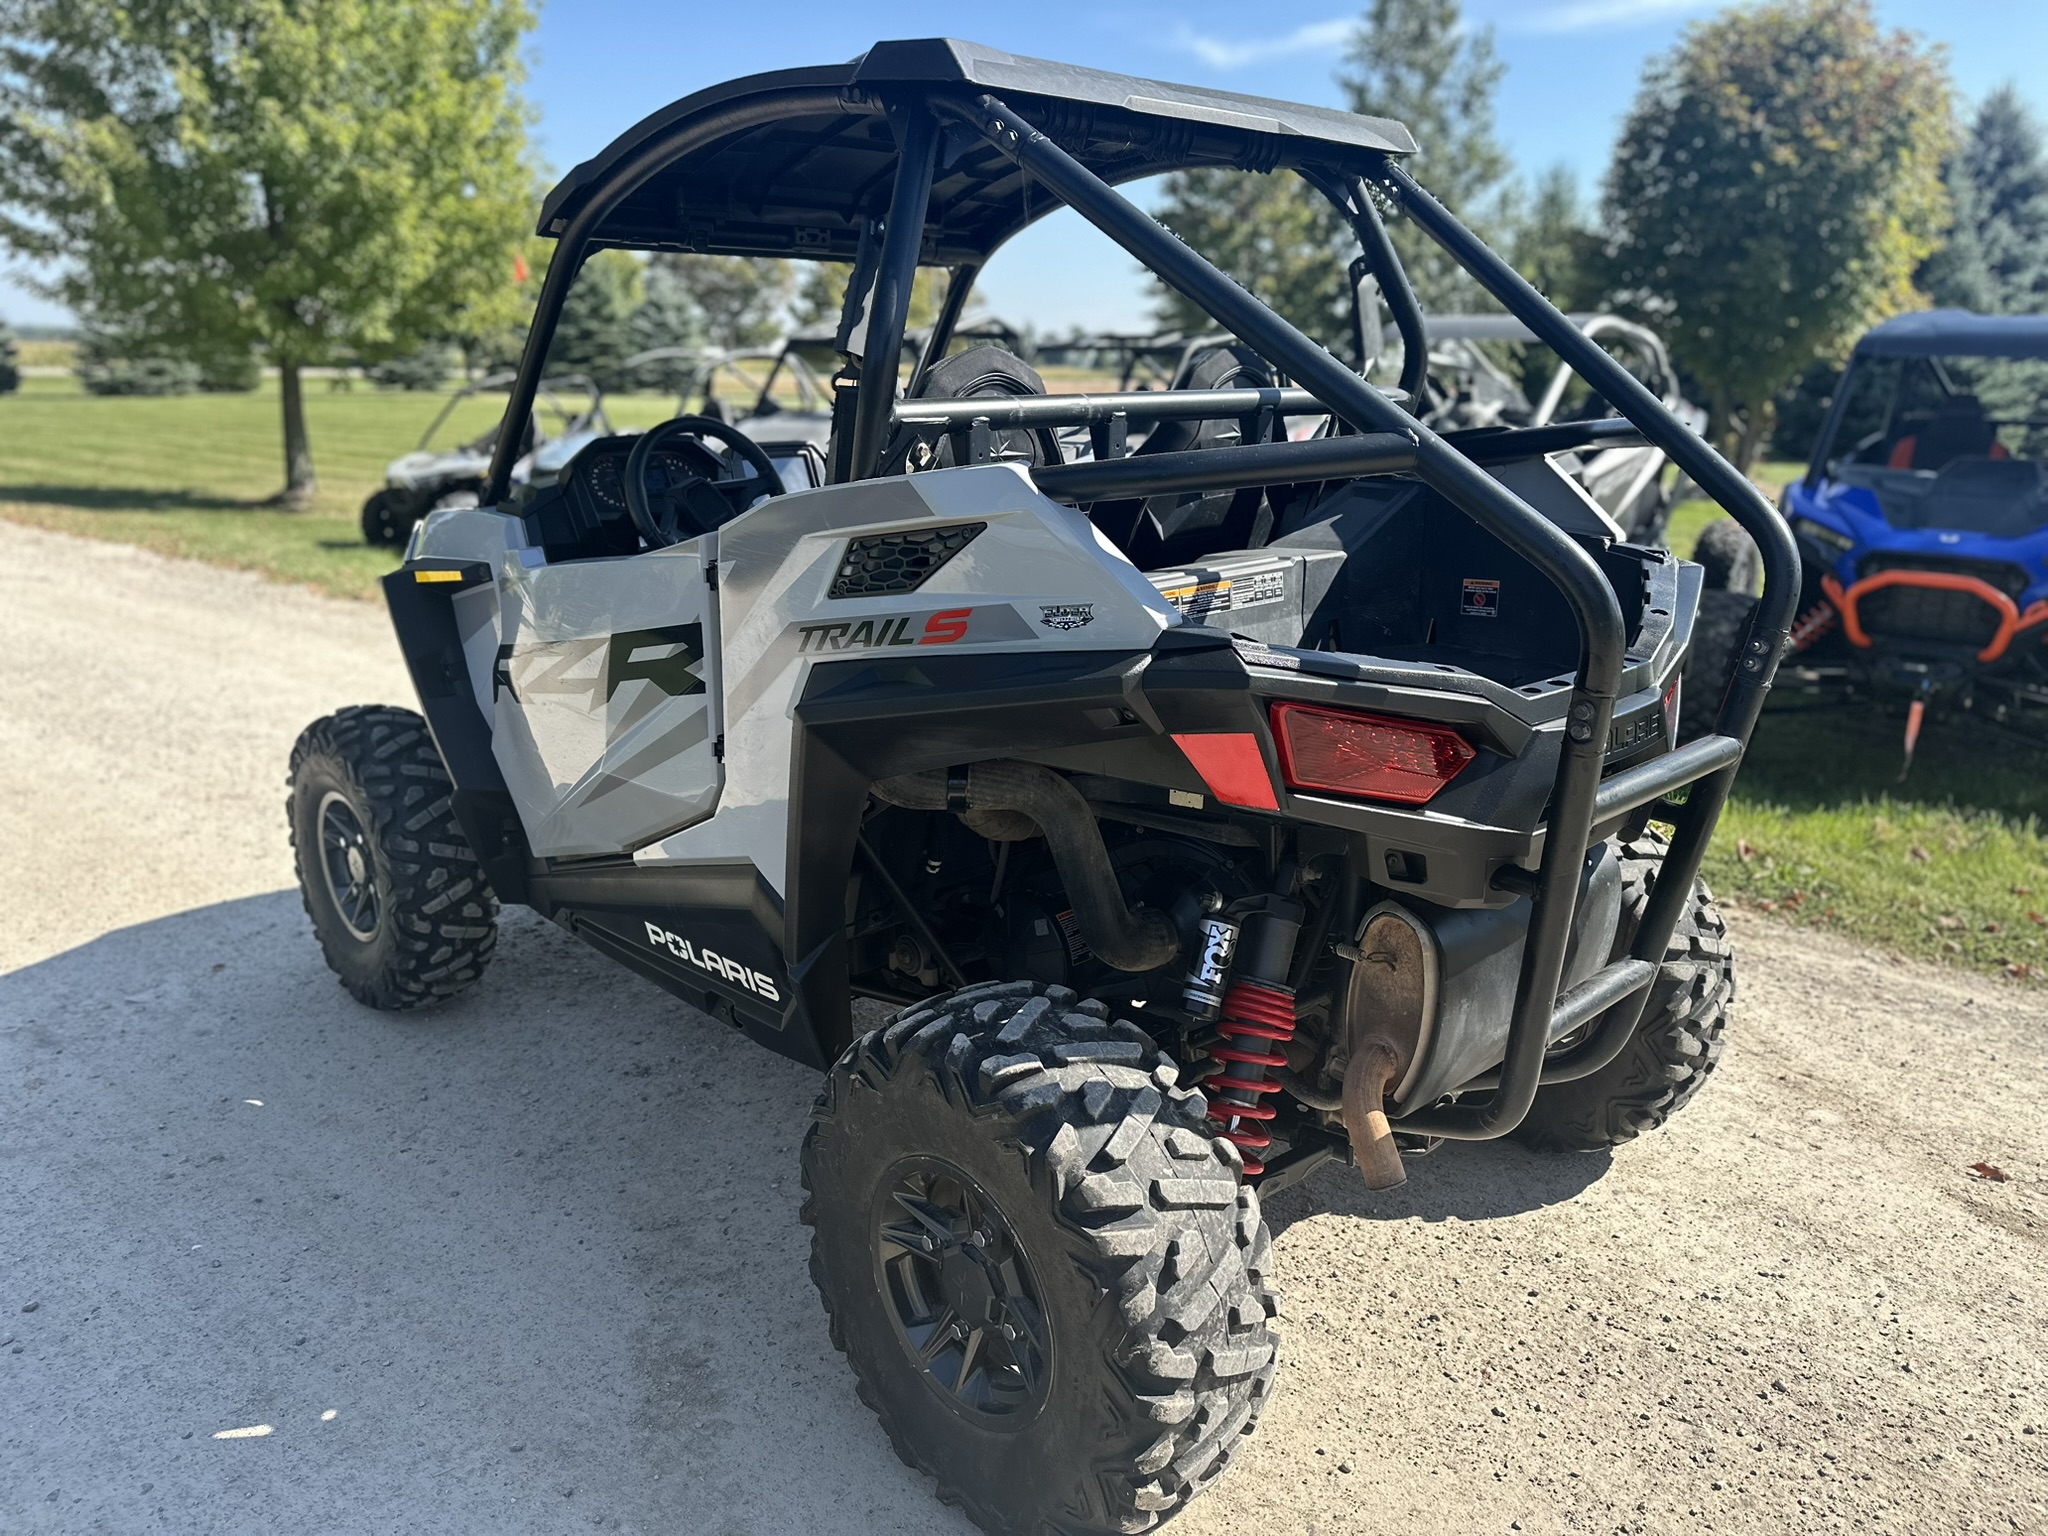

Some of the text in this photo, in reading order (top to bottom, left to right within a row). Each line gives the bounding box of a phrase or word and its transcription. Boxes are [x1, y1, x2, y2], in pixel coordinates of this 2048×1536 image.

[798, 608, 973, 652] TRAIL S
[644, 920, 780, 1002] POLARIS
[1200, 924, 1234, 985] FOX
